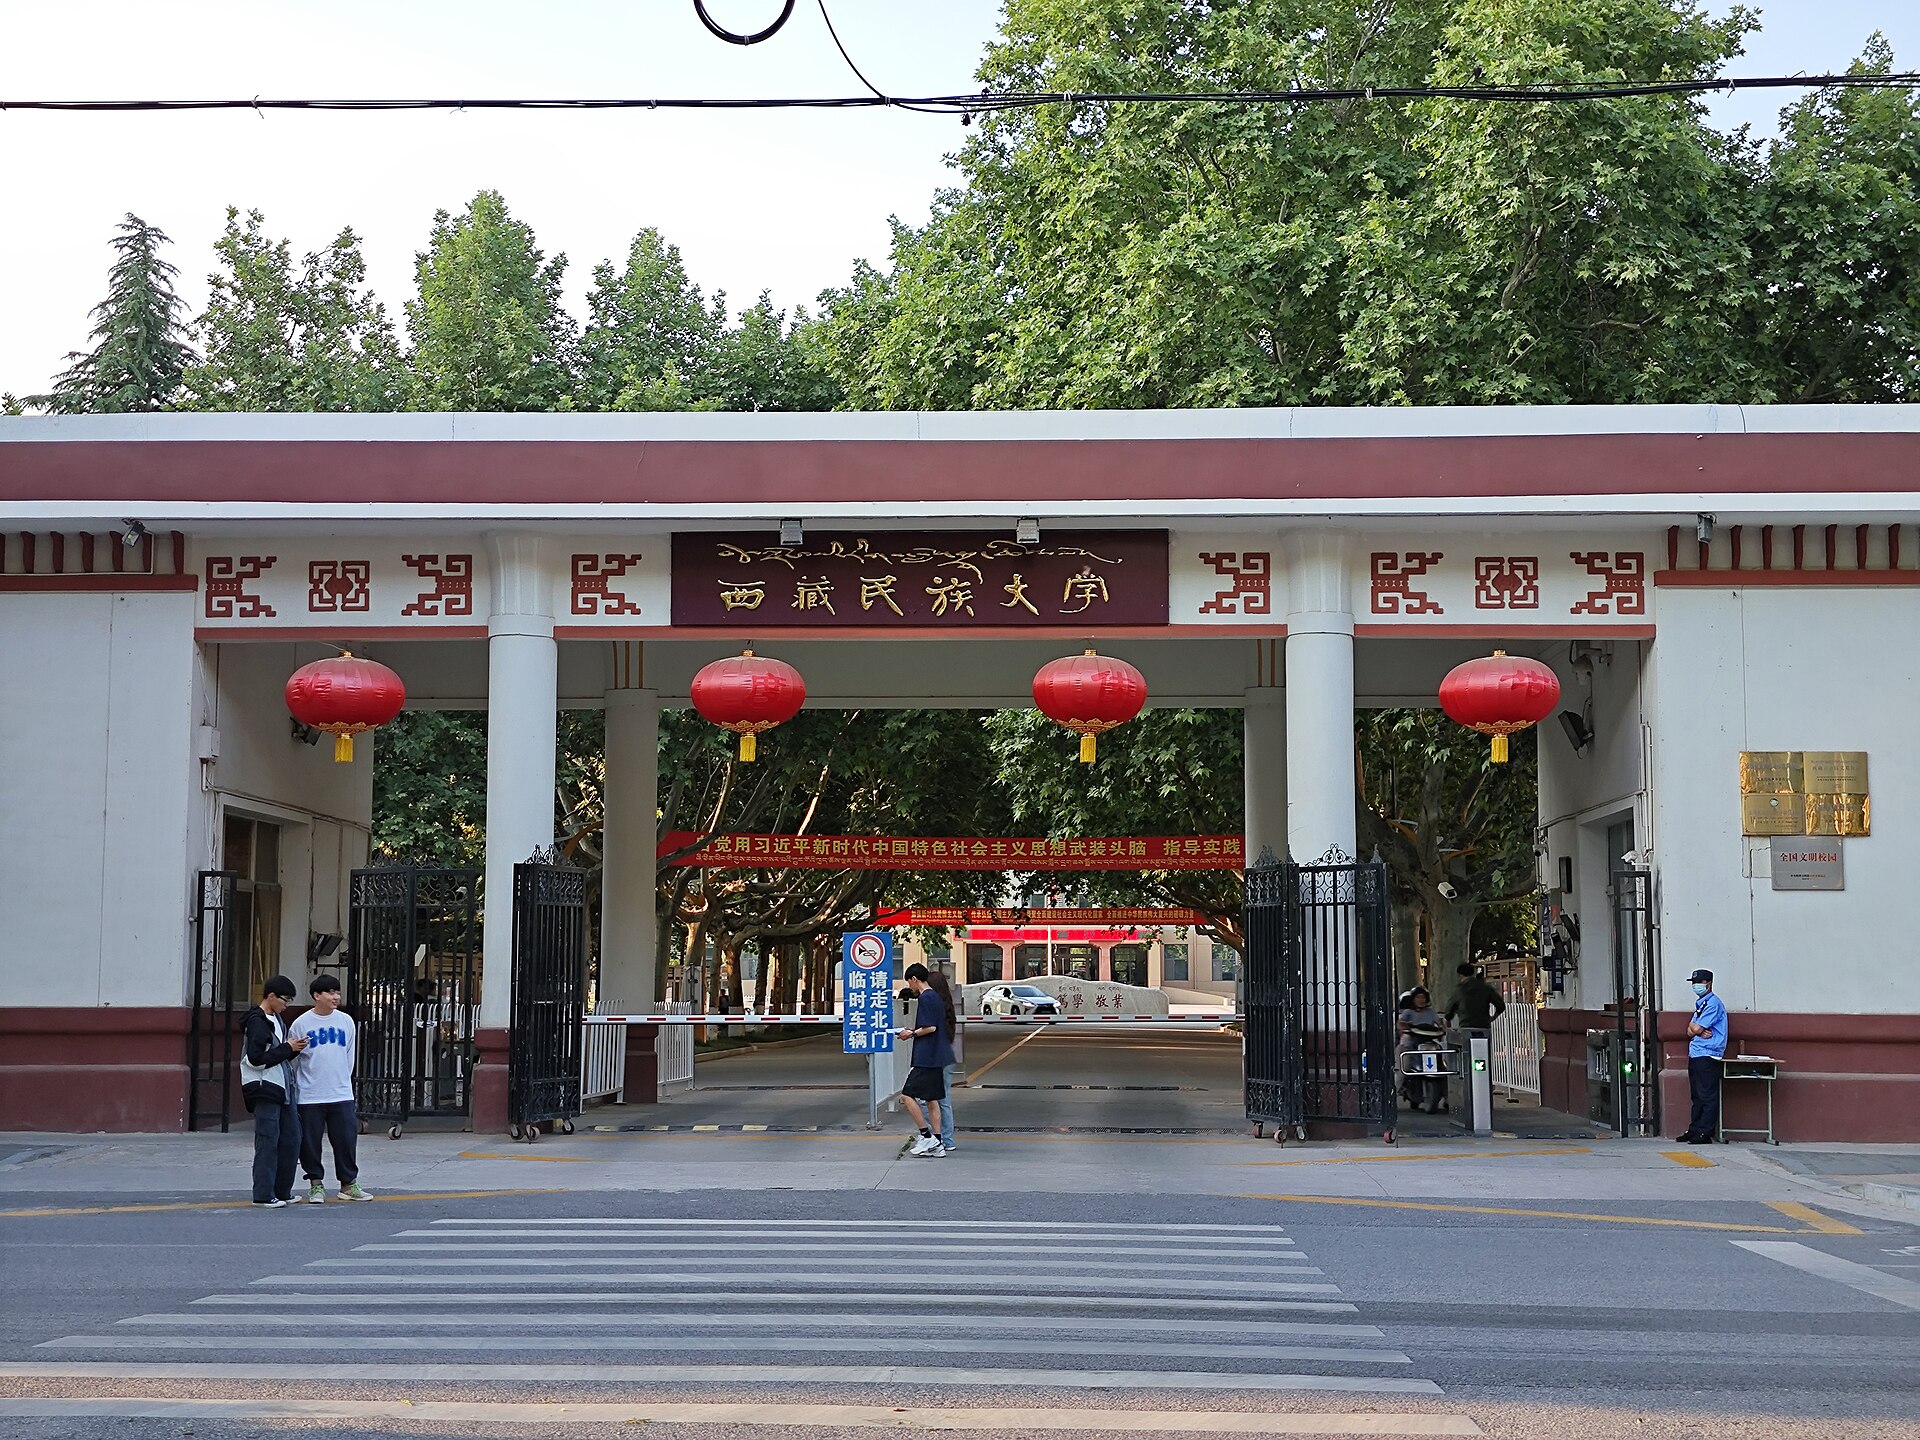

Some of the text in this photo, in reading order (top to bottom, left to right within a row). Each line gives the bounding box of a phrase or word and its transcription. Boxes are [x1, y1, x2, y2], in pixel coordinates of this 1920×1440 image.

[717, 574, 1110, 617] 西藏民族大学
[1164, 838, 1242, 856] 指导实践
[1780, 852, 1837, 862] 全国文明校园
[848, 971, 868, 1049] 临时车辆
[869, 971, 888, 1049] 请走北门
